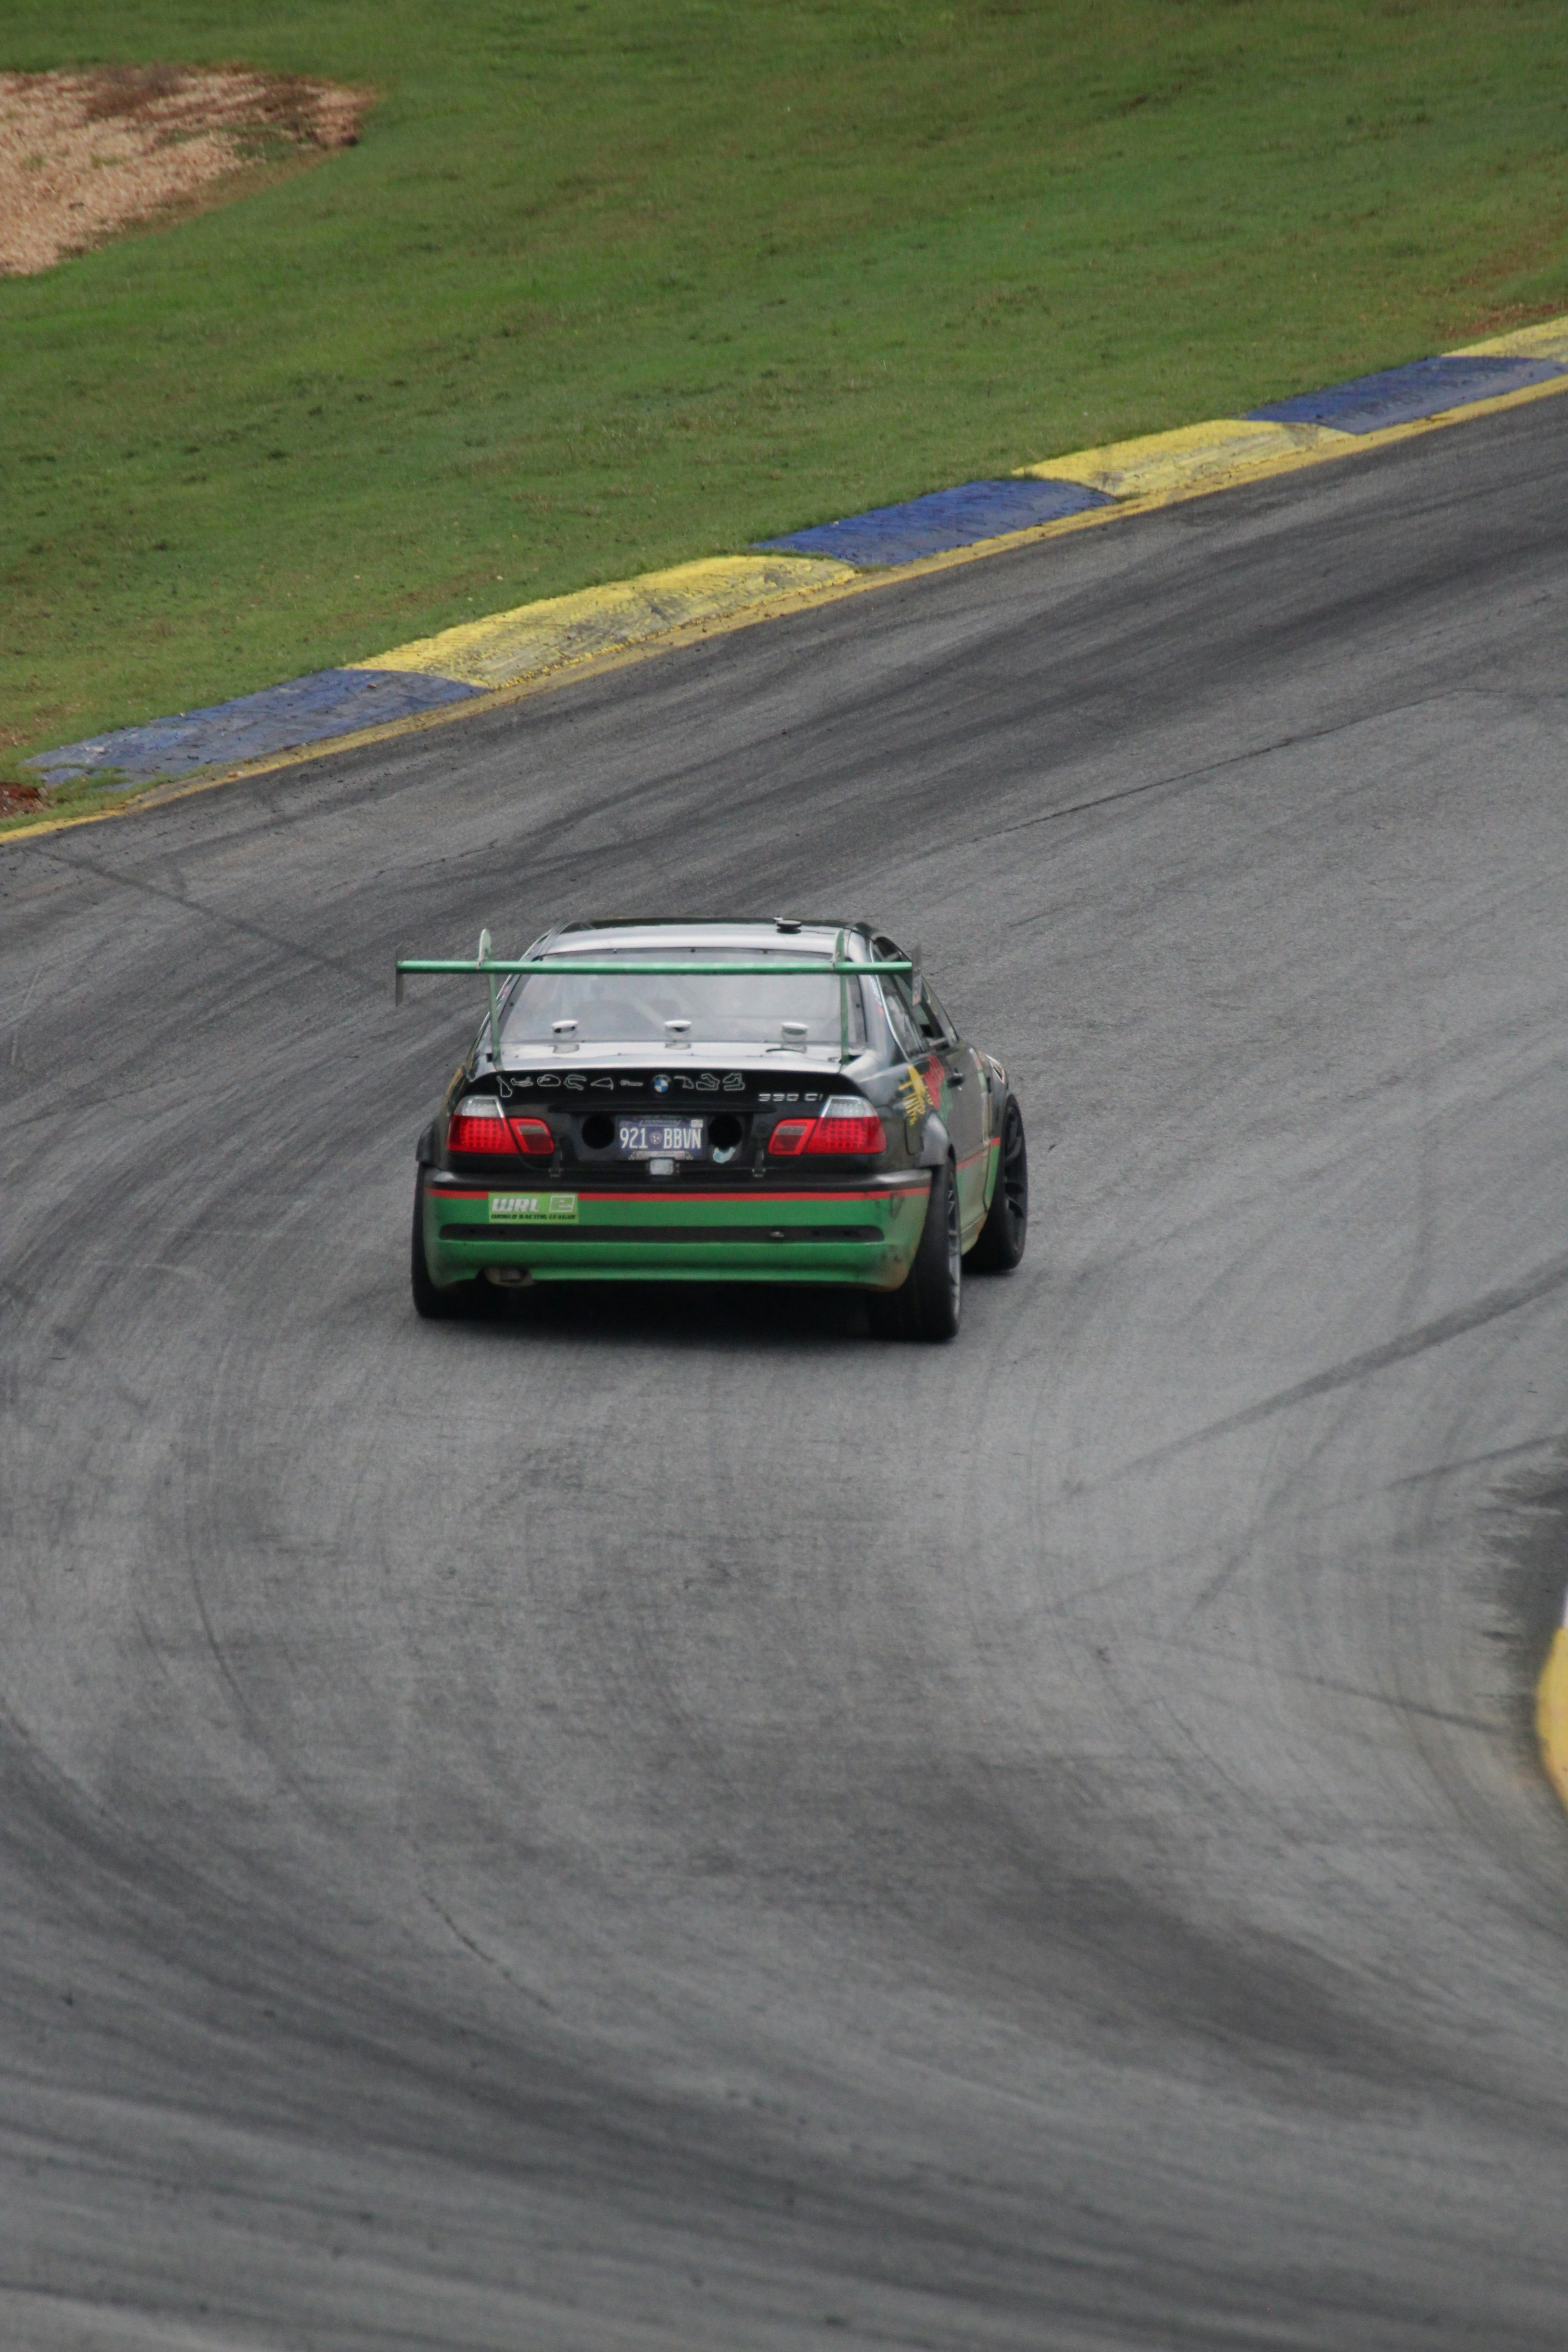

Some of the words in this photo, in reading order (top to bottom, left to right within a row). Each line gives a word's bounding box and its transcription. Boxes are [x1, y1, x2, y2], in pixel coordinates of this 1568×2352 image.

[758, 1093, 799, 1102] 330
[619, 1127, 648, 1149] 921
[663, 1127, 701, 1149] BBVN
[491, 1198, 539, 1212] WRL
